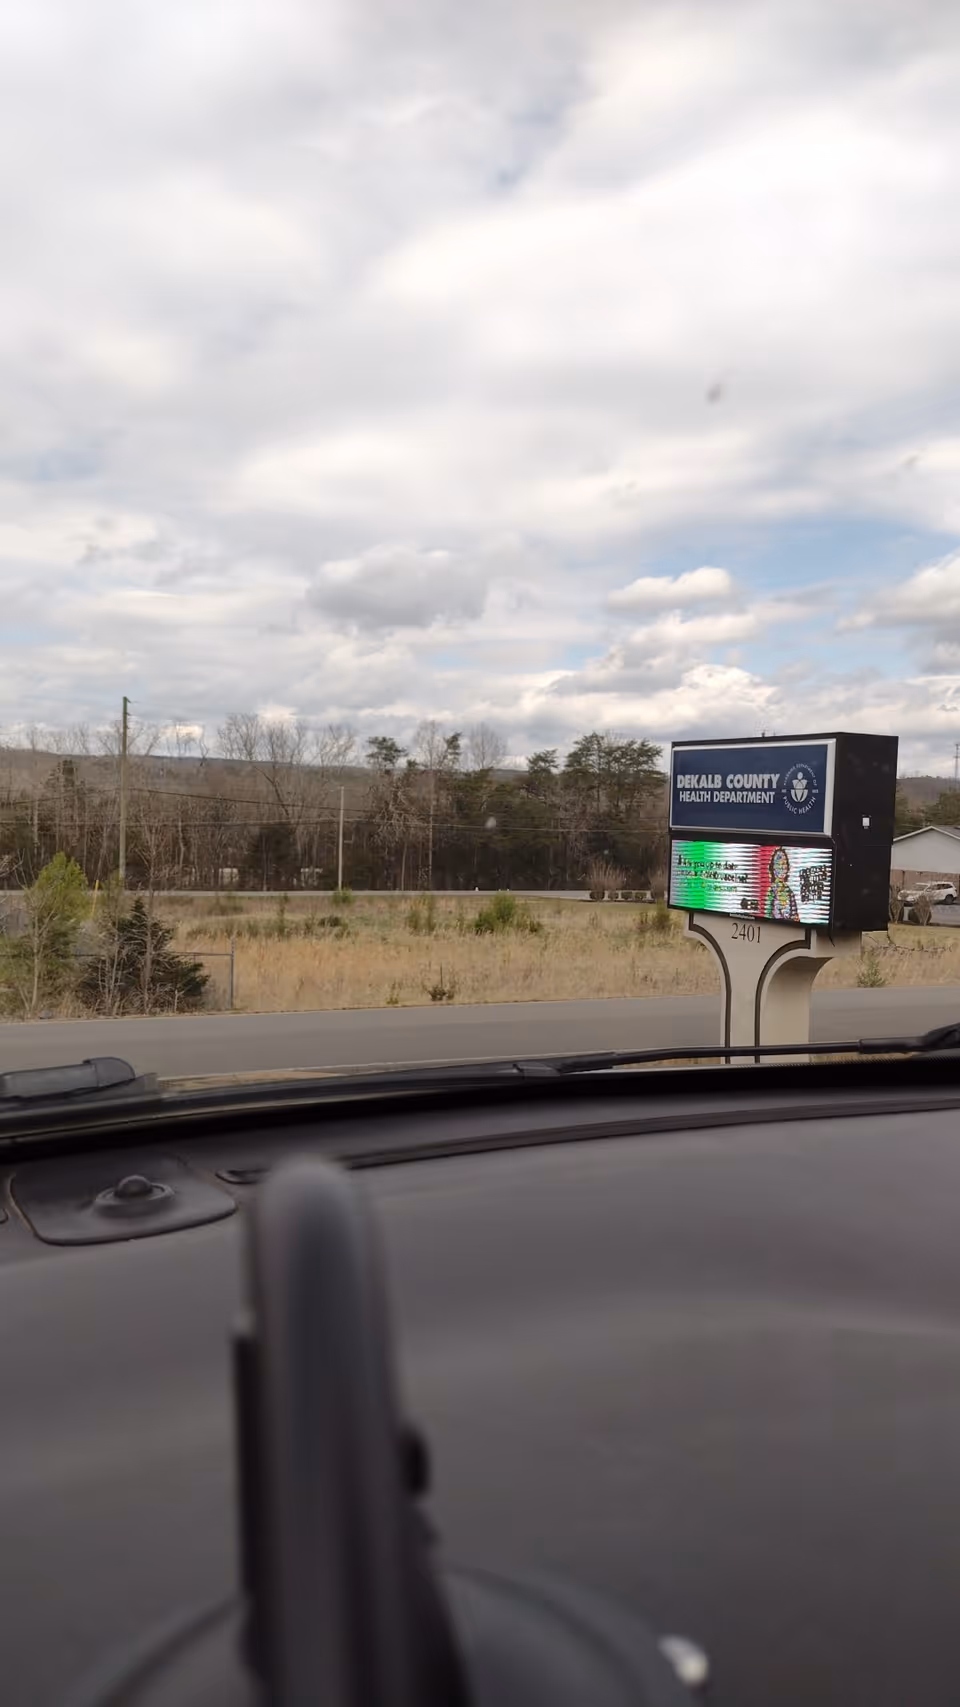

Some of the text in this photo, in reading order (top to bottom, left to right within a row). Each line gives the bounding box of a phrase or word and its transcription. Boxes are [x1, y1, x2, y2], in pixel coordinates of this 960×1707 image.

[676, 774, 722, 789] DEKALB
[726, 773, 780, 789] COUNTY
[679, 791, 775, 804] HEALTH DEPARTMENT
[783, 796, 816, 814] PUBLIC HEALTH
[731, 922, 761, 944] 2401
